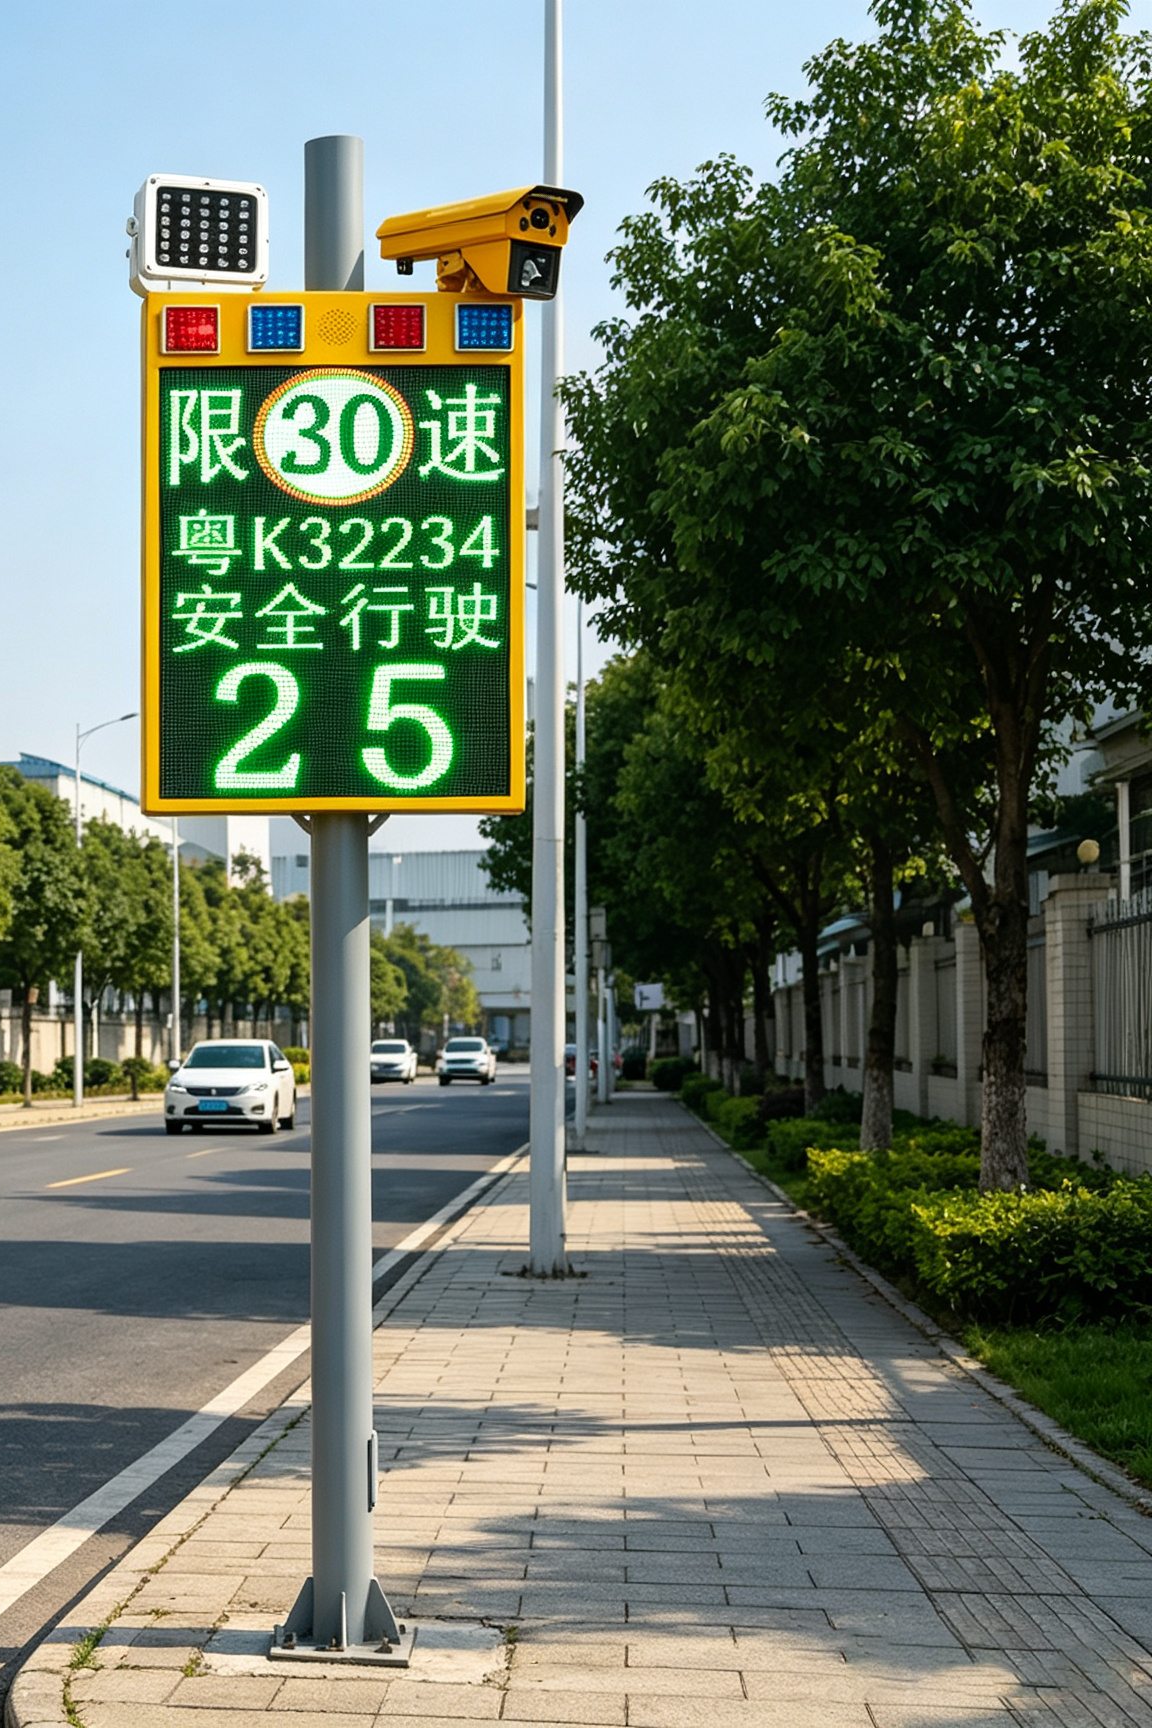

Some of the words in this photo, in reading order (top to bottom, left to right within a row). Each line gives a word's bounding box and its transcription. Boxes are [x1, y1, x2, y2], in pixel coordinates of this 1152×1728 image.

[169, 388, 248, 486] 限
[280, 393, 394, 476] 30
[418, 384, 506, 481] 速
[171, 582, 501, 652] 安全行驶
